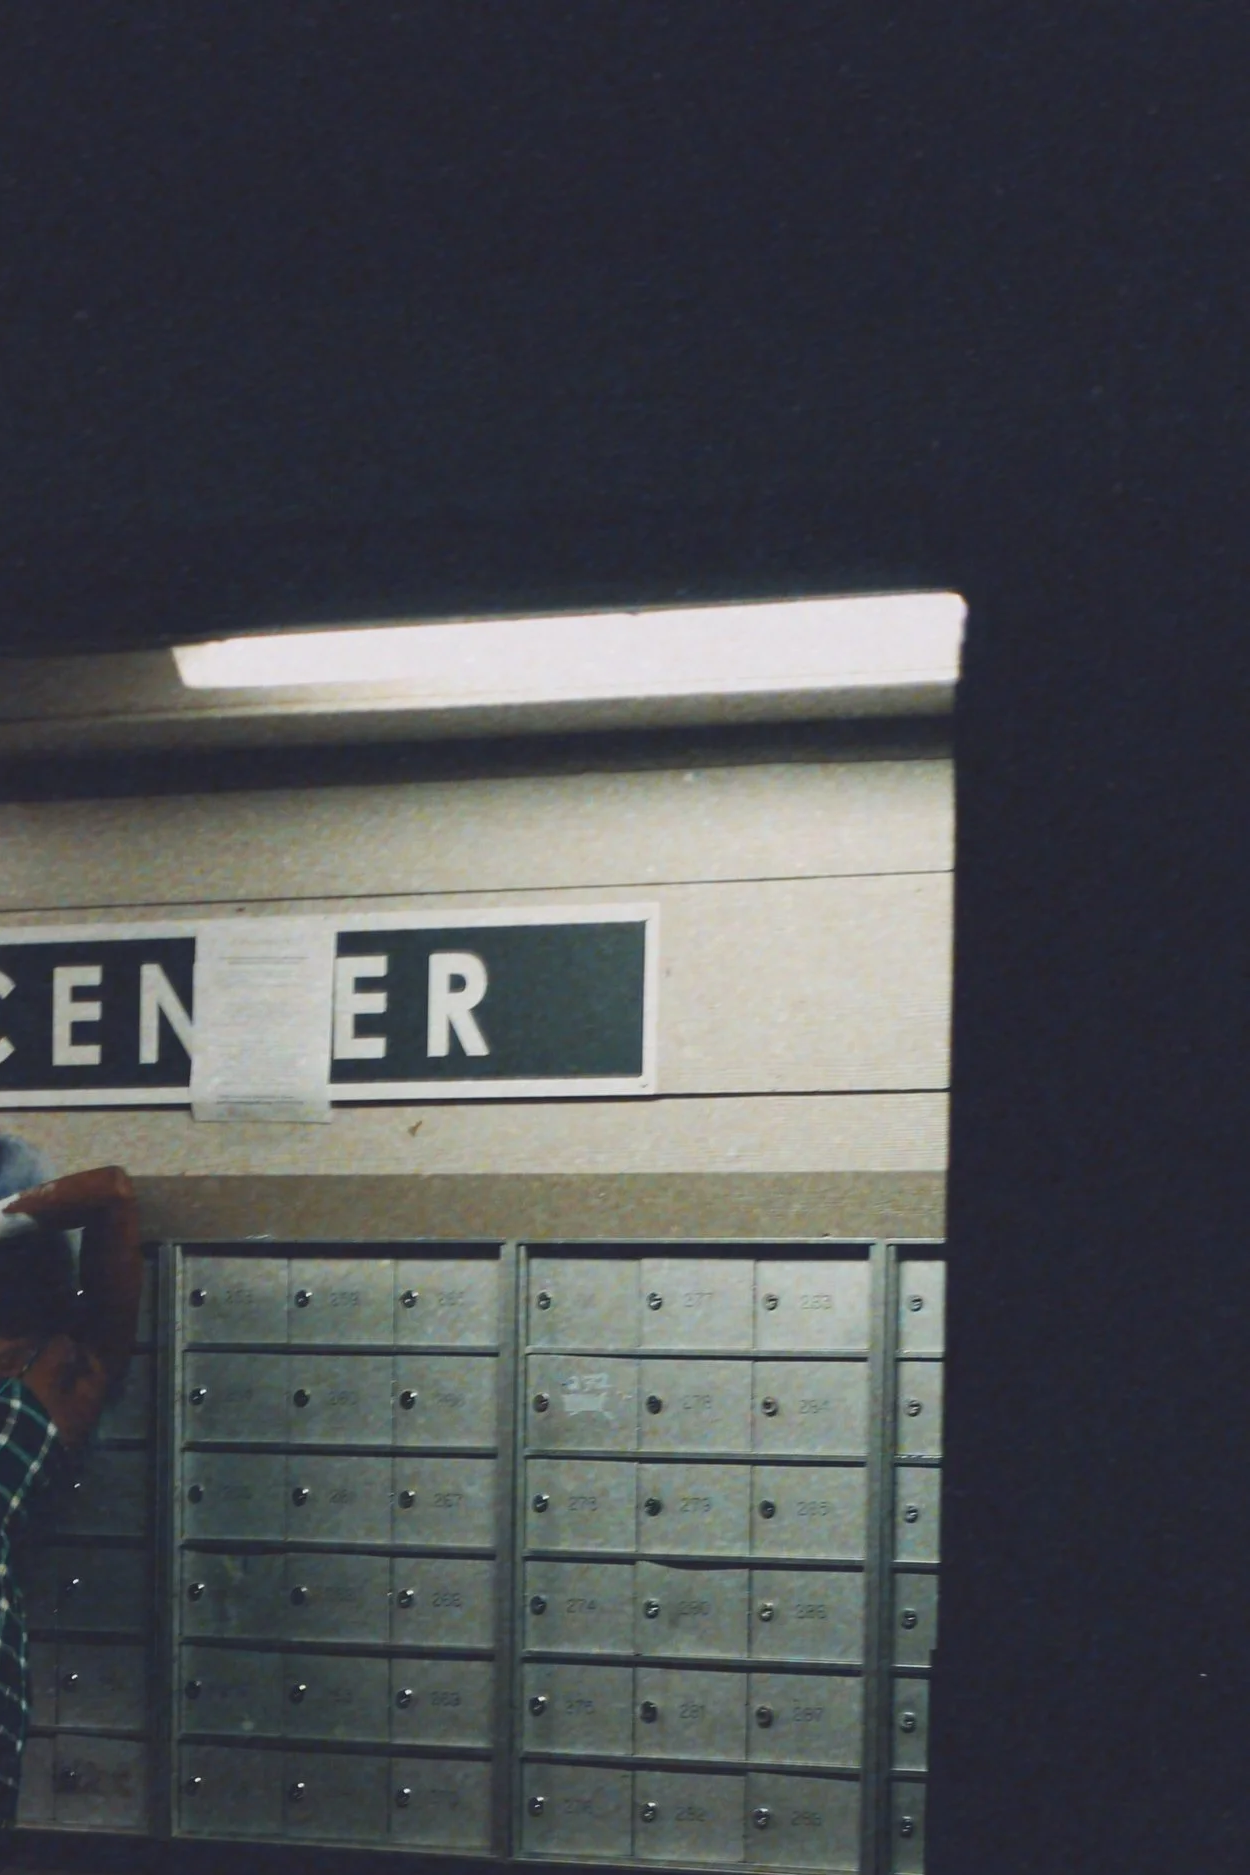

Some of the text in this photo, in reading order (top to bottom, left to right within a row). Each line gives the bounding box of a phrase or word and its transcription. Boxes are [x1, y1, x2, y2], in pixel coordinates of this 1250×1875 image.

[684, 1292, 714, 1307] 277
[801, 1294, 832, 1310] 283
[799, 1399, 830, 1414] 284
[434, 1492, 464, 1508] 267
[568, 1496, 598, 1511] 273
[566, 1599, 597, 1614] 274
[679, 1704, 706, 1719] 281
